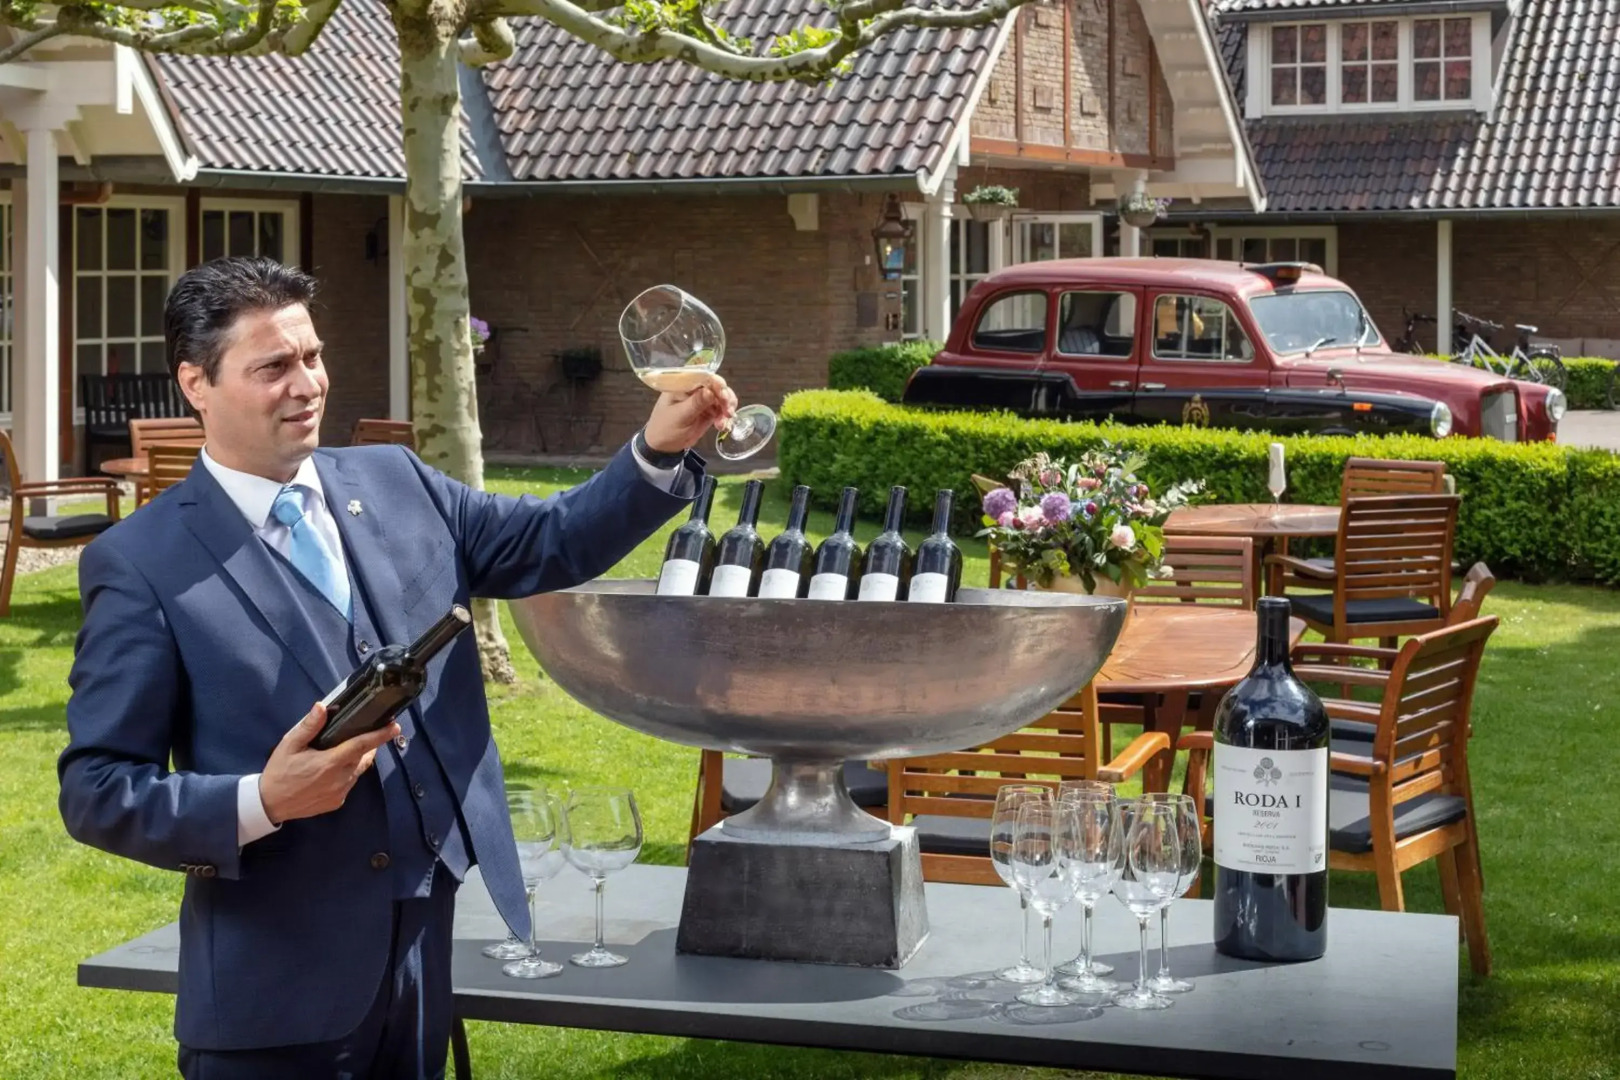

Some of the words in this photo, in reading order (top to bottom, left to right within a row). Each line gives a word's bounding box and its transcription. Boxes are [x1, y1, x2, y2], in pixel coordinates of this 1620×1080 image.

[1234, 791, 1288, 808] RODA
[1295, 795, 1302, 808] I
[1252, 810, 1280, 818] RESERVA
[1255, 855, 1276, 863] RIOJA
